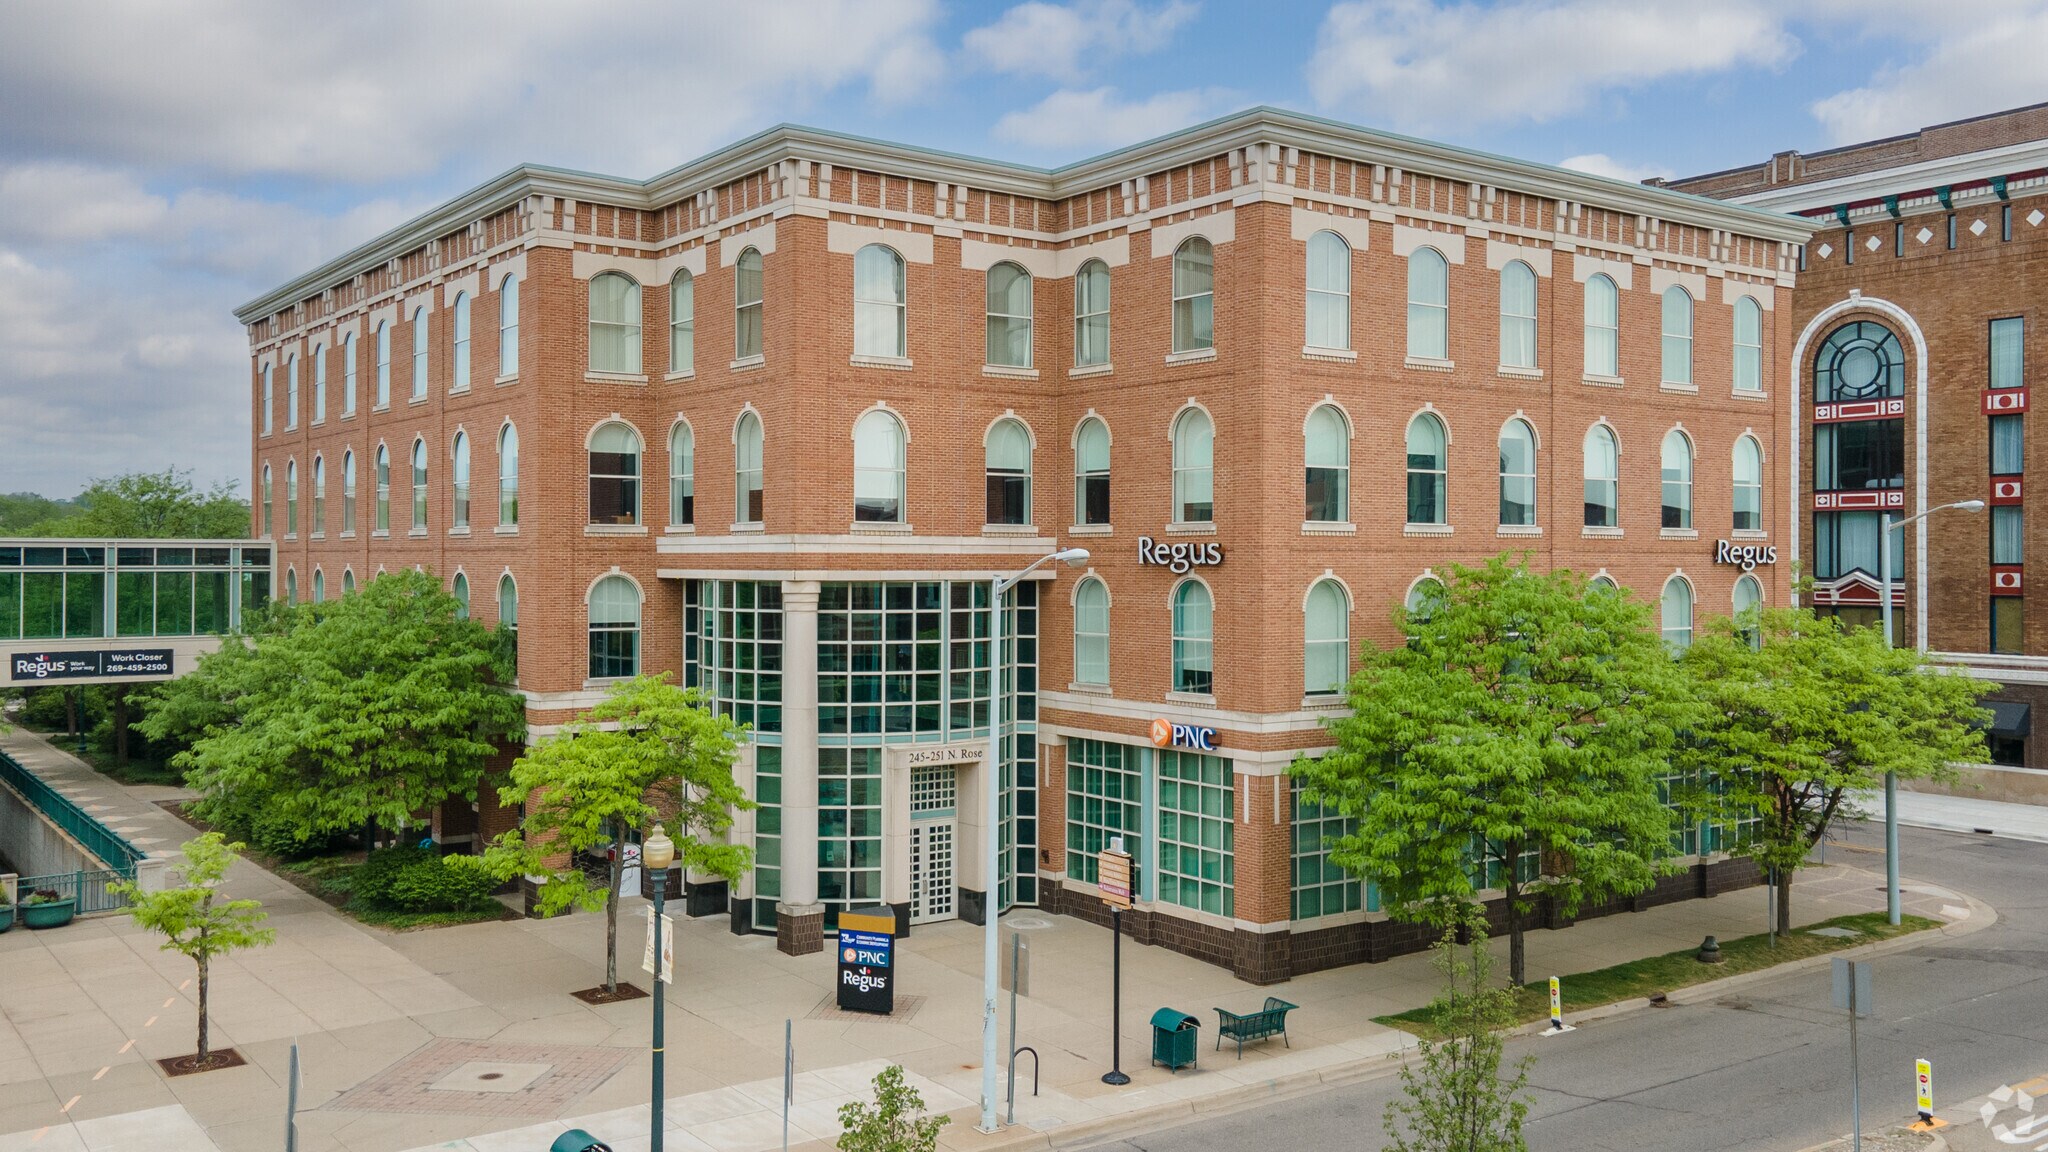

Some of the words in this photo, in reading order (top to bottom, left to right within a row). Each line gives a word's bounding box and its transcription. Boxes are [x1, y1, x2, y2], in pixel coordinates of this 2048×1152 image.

[1138, 536, 1222, 574] Regus
[1717, 539, 1777, 571] Regus
[111, 654, 134, 662] Work
[135, 653, 164, 661] Closer
[16, 660, 66, 678] Regus
[106, 663, 168, 672] 269-459-2500
[1171, 724, 1213, 751] PNC
[909, 751, 944, 763] 245-251
[961, 749, 983, 759] Rose
[858, 950, 886, 965] PNC
[843, 970, 886, 992] Regus
